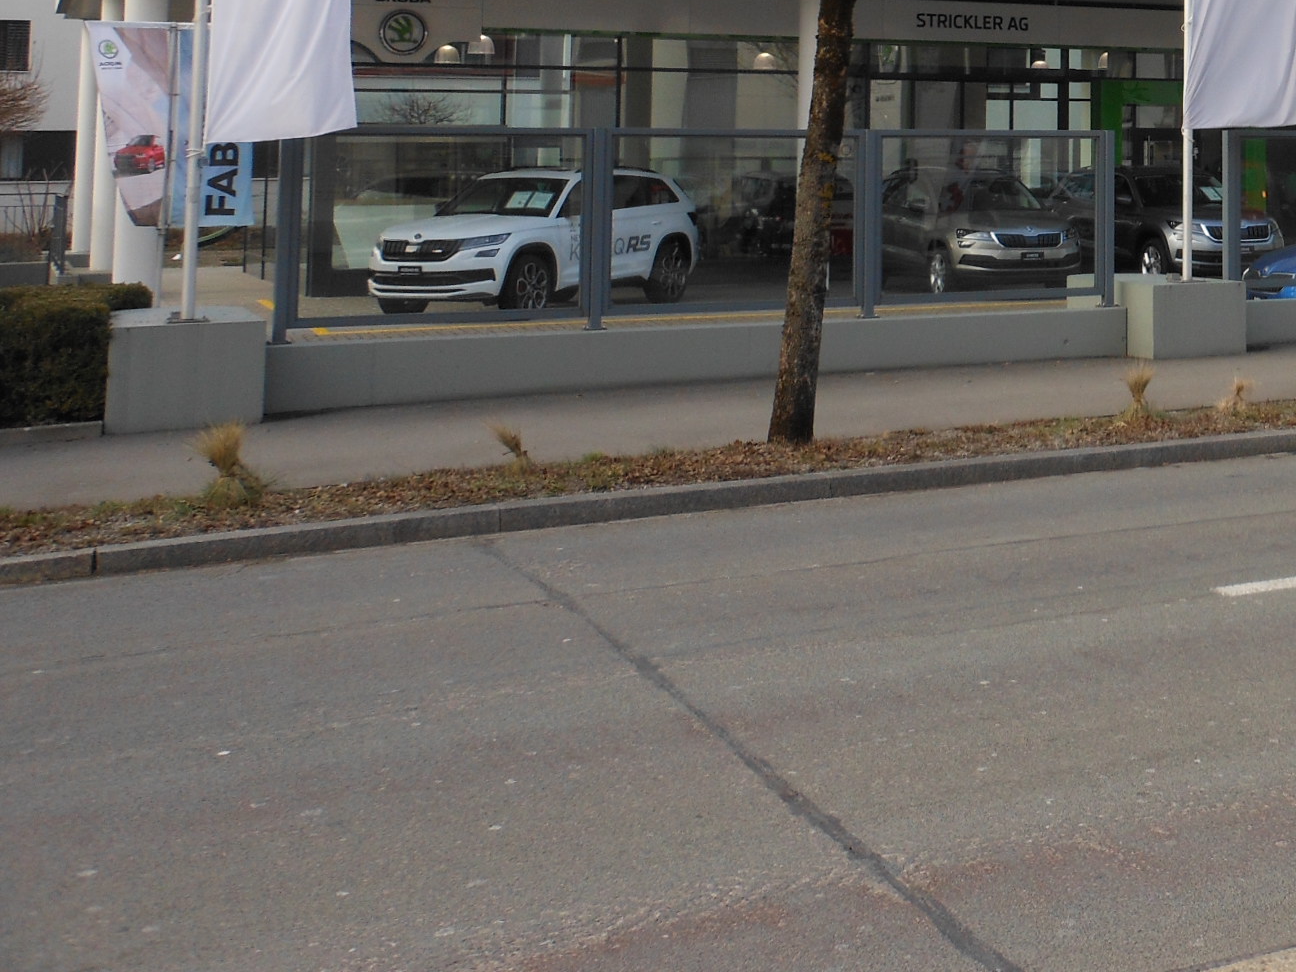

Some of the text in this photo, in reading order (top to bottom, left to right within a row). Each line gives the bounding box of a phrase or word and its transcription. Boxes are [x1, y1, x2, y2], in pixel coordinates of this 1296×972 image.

[916, 12, 1029, 31] STRICKLER AG
[205, 141, 239, 217] FAB
